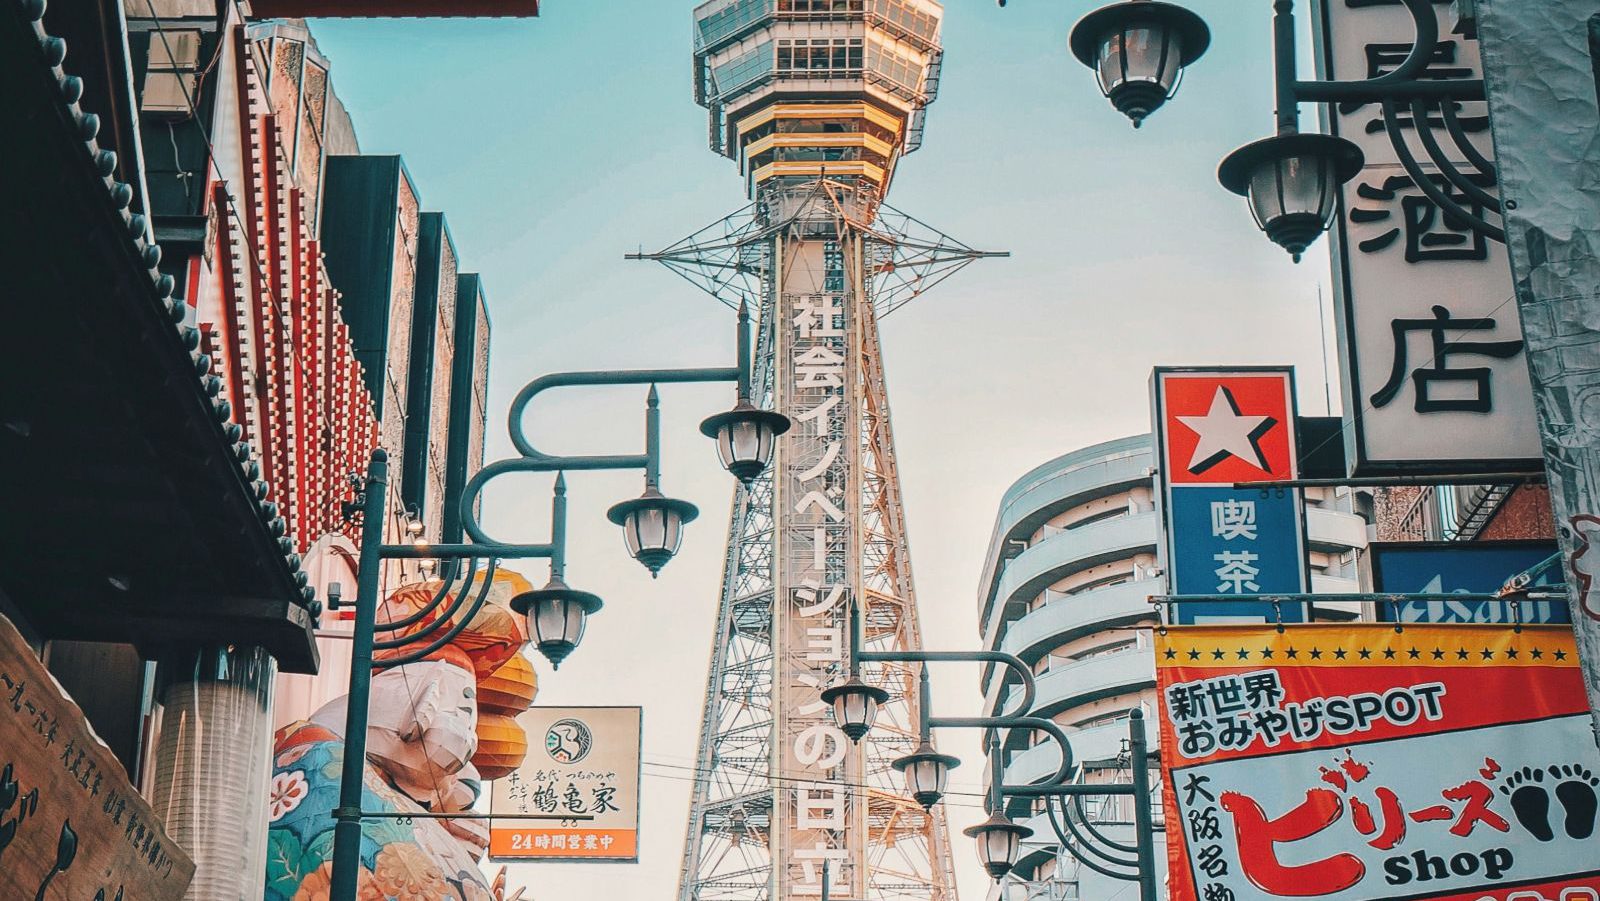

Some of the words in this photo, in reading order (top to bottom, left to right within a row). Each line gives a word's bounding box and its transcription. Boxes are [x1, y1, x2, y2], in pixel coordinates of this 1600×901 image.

[1211, 500, 1261, 594] 喫茶
[1168, 672, 1282, 721] 新世界
[1178, 687, 1444, 754] おみやげSPOT
[532, 781, 620, 814] 鶴亀家
[1219, 748, 1512, 897] ビリーズ
[511, 834, 614, 850] 24時間営業中
